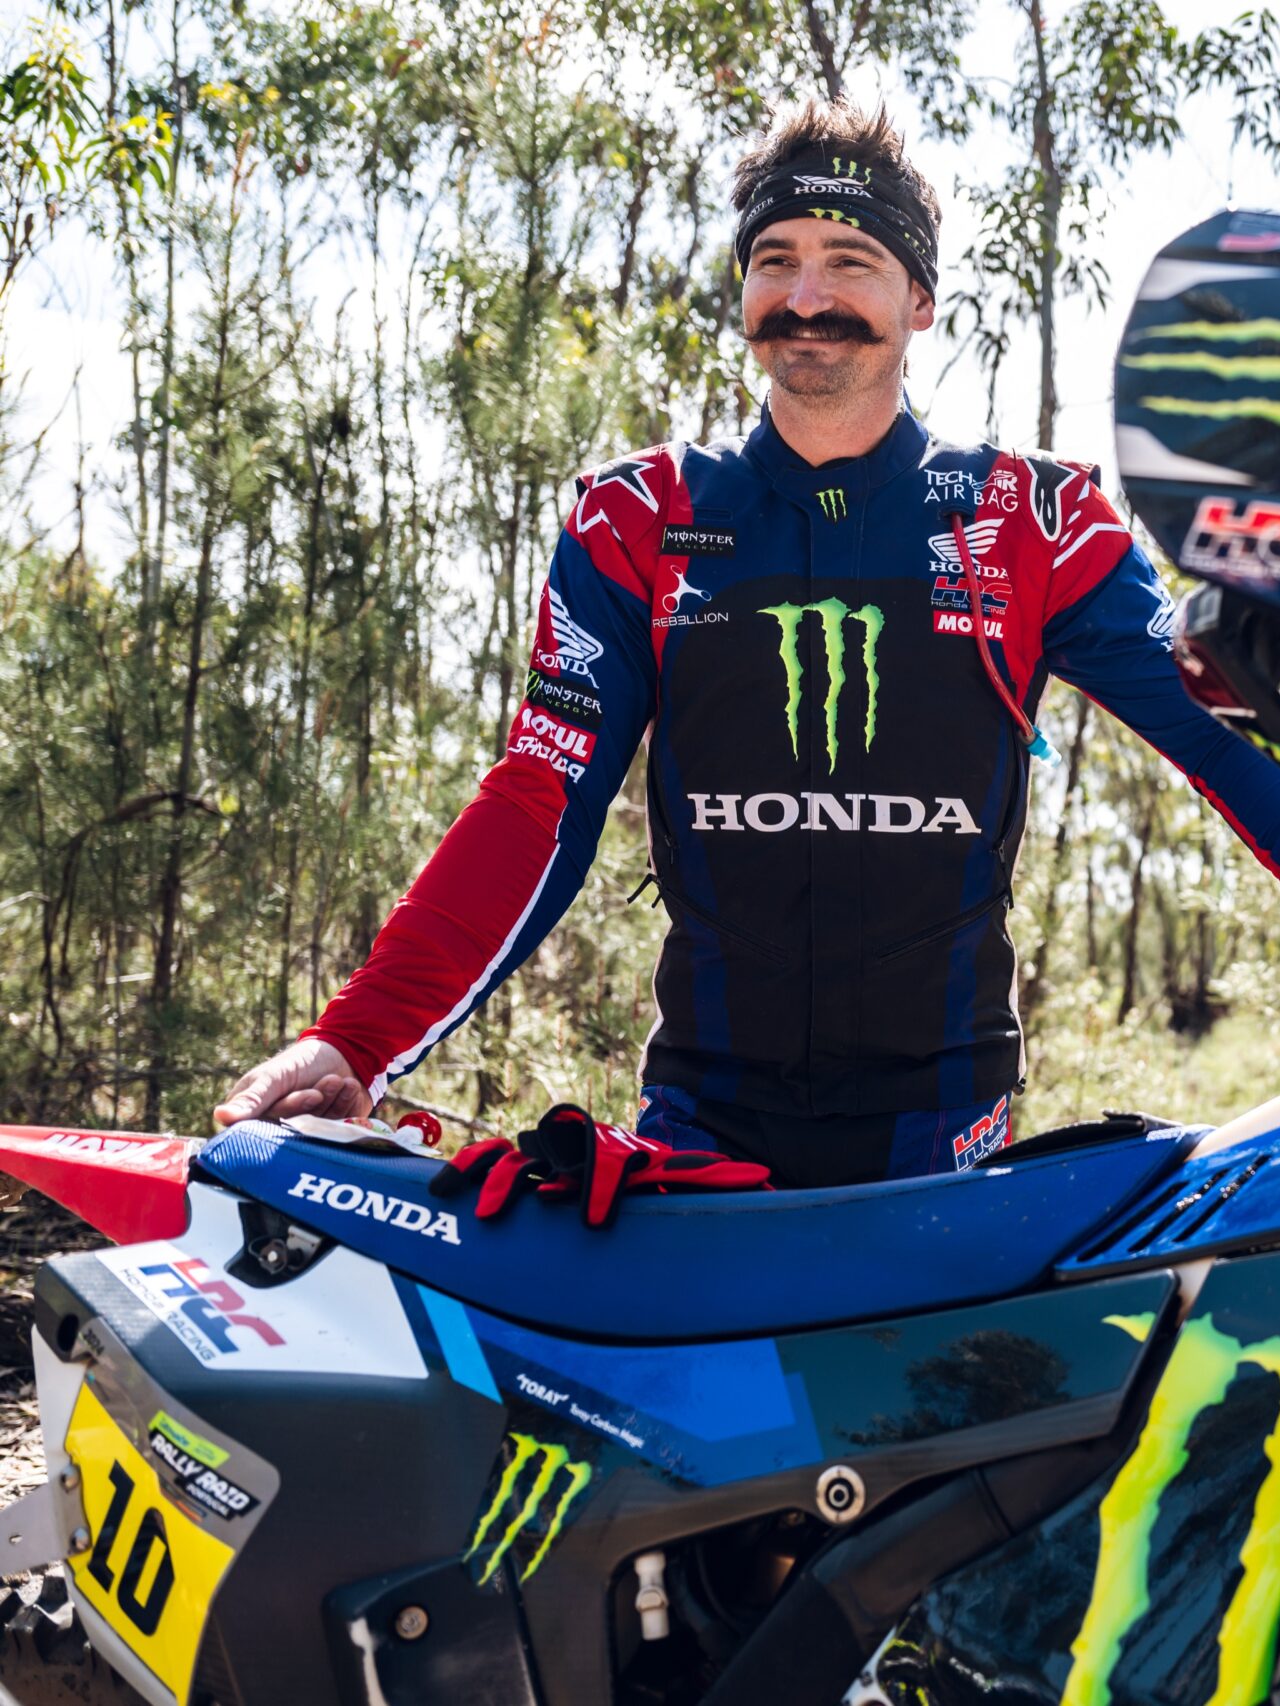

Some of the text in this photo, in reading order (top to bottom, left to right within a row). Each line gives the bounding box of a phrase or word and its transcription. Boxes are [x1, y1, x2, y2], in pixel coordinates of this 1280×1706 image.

[793, 184, 873, 199] HONDA
[667, 531, 734, 547] MONSTER
[652, 612, 729, 629] REBELLION
[938, 614, 1004, 639] MOUL
[521, 708, 588, 758] MOTUL
[687, 792, 982, 834] HONDA
[953, 1094, 1007, 1172] HRC
[288, 1172, 462, 1245] HONDA
[138, 1257, 288, 1354] HRC
[164, 1308, 217, 1361] RACING
[151, 1433, 203, 1477] RALLY
[195, 1470, 250, 1510] RAID
[87, 1459, 176, 1637] 10
